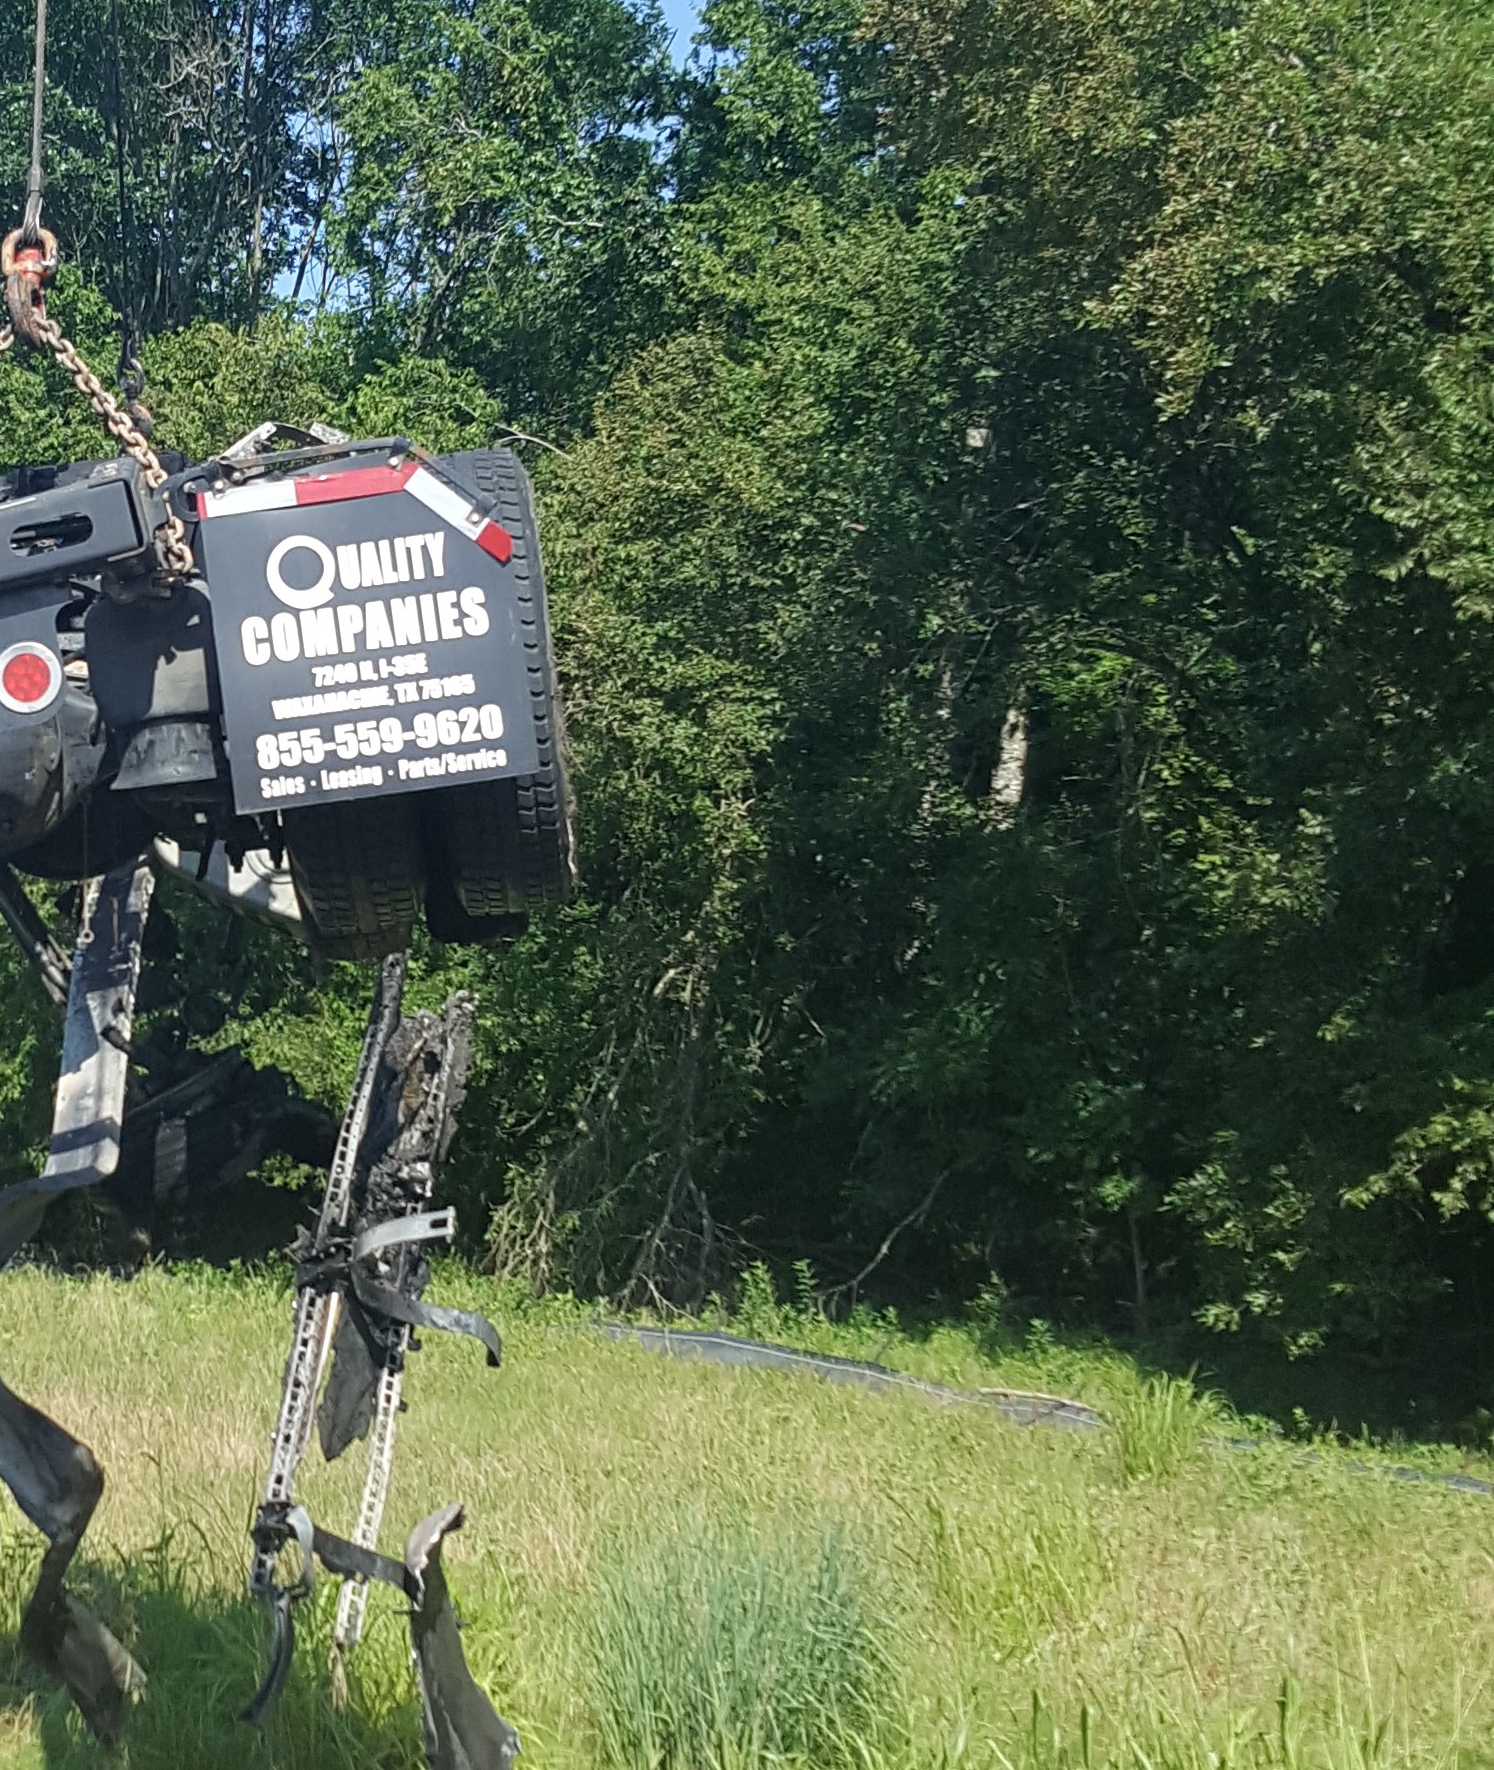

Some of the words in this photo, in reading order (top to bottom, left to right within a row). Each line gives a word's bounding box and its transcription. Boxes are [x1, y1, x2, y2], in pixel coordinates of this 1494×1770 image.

[267, 531, 446, 609] QUALITY
[240, 586, 490, 666] COMPANIES
[393, 681, 420, 704] TX
[256, 704, 504, 770] 855-559-9620
[260, 776, 306, 799] Sales
[320, 765, 383, 790] Leasing
[397, 748, 507, 780] Parts/Service
